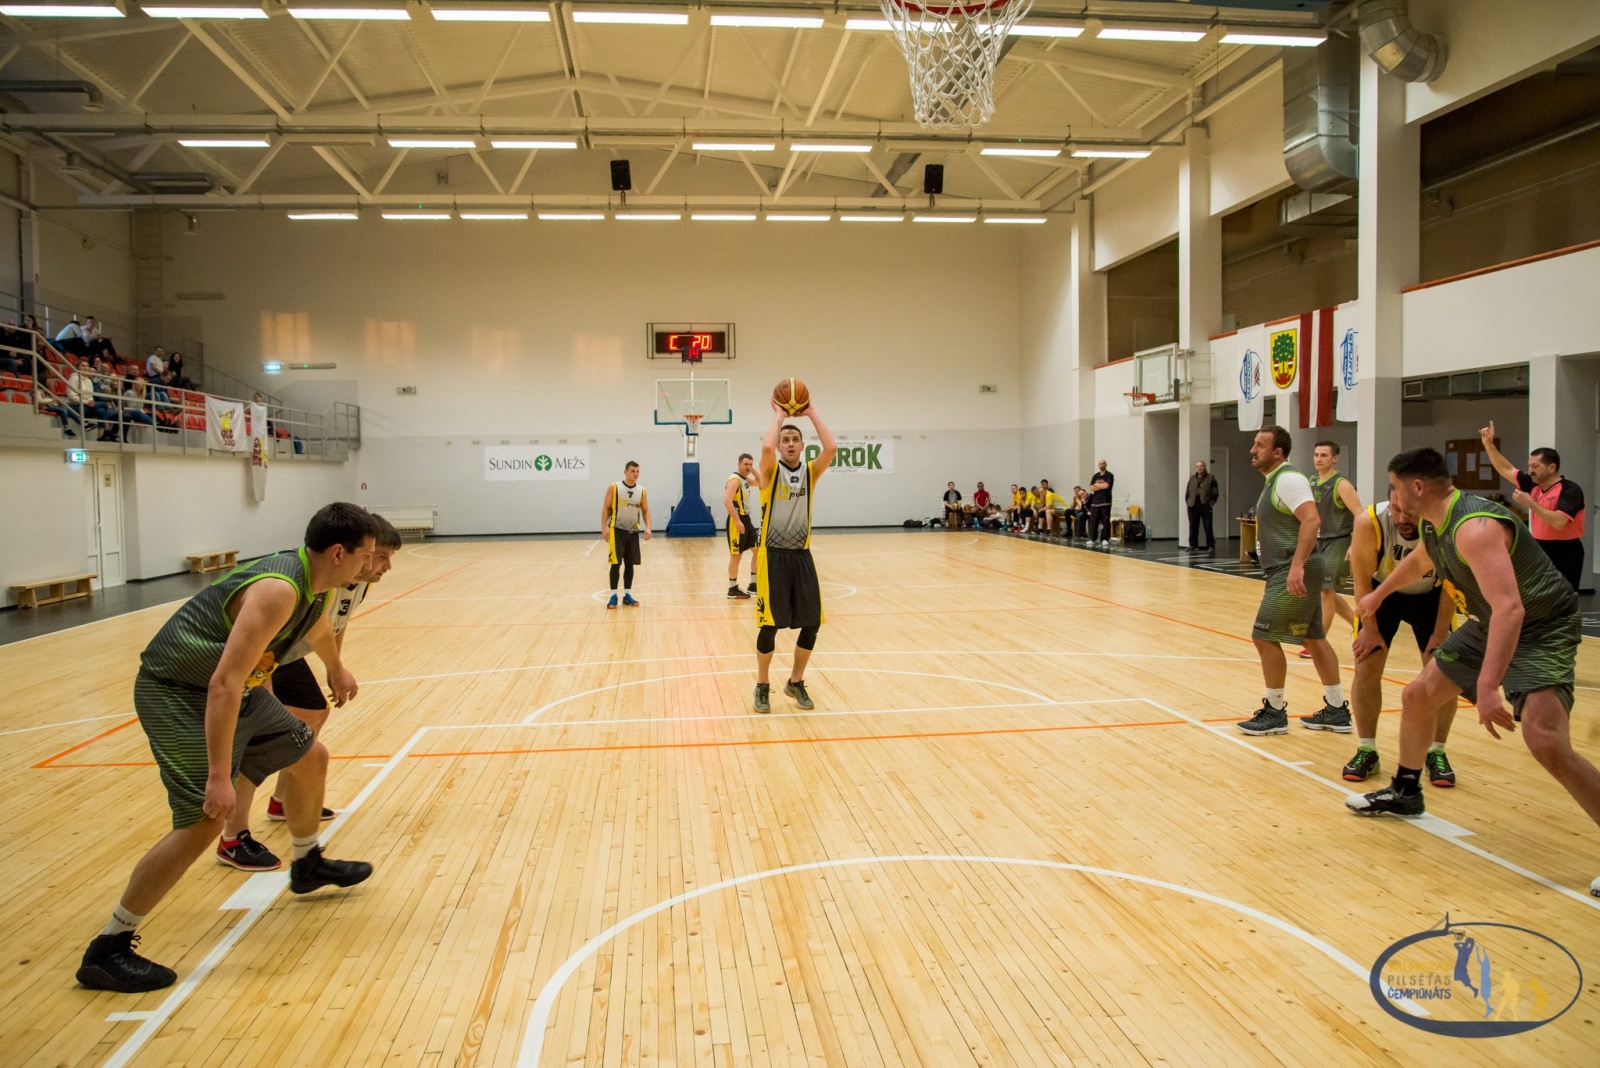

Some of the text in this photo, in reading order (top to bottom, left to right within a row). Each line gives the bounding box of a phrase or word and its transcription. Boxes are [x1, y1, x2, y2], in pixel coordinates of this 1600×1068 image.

[489, 456, 586, 471] SUNDIN MEŽS
[627, 491, 634, 499] 7
[337, 599, 351, 616] 3
